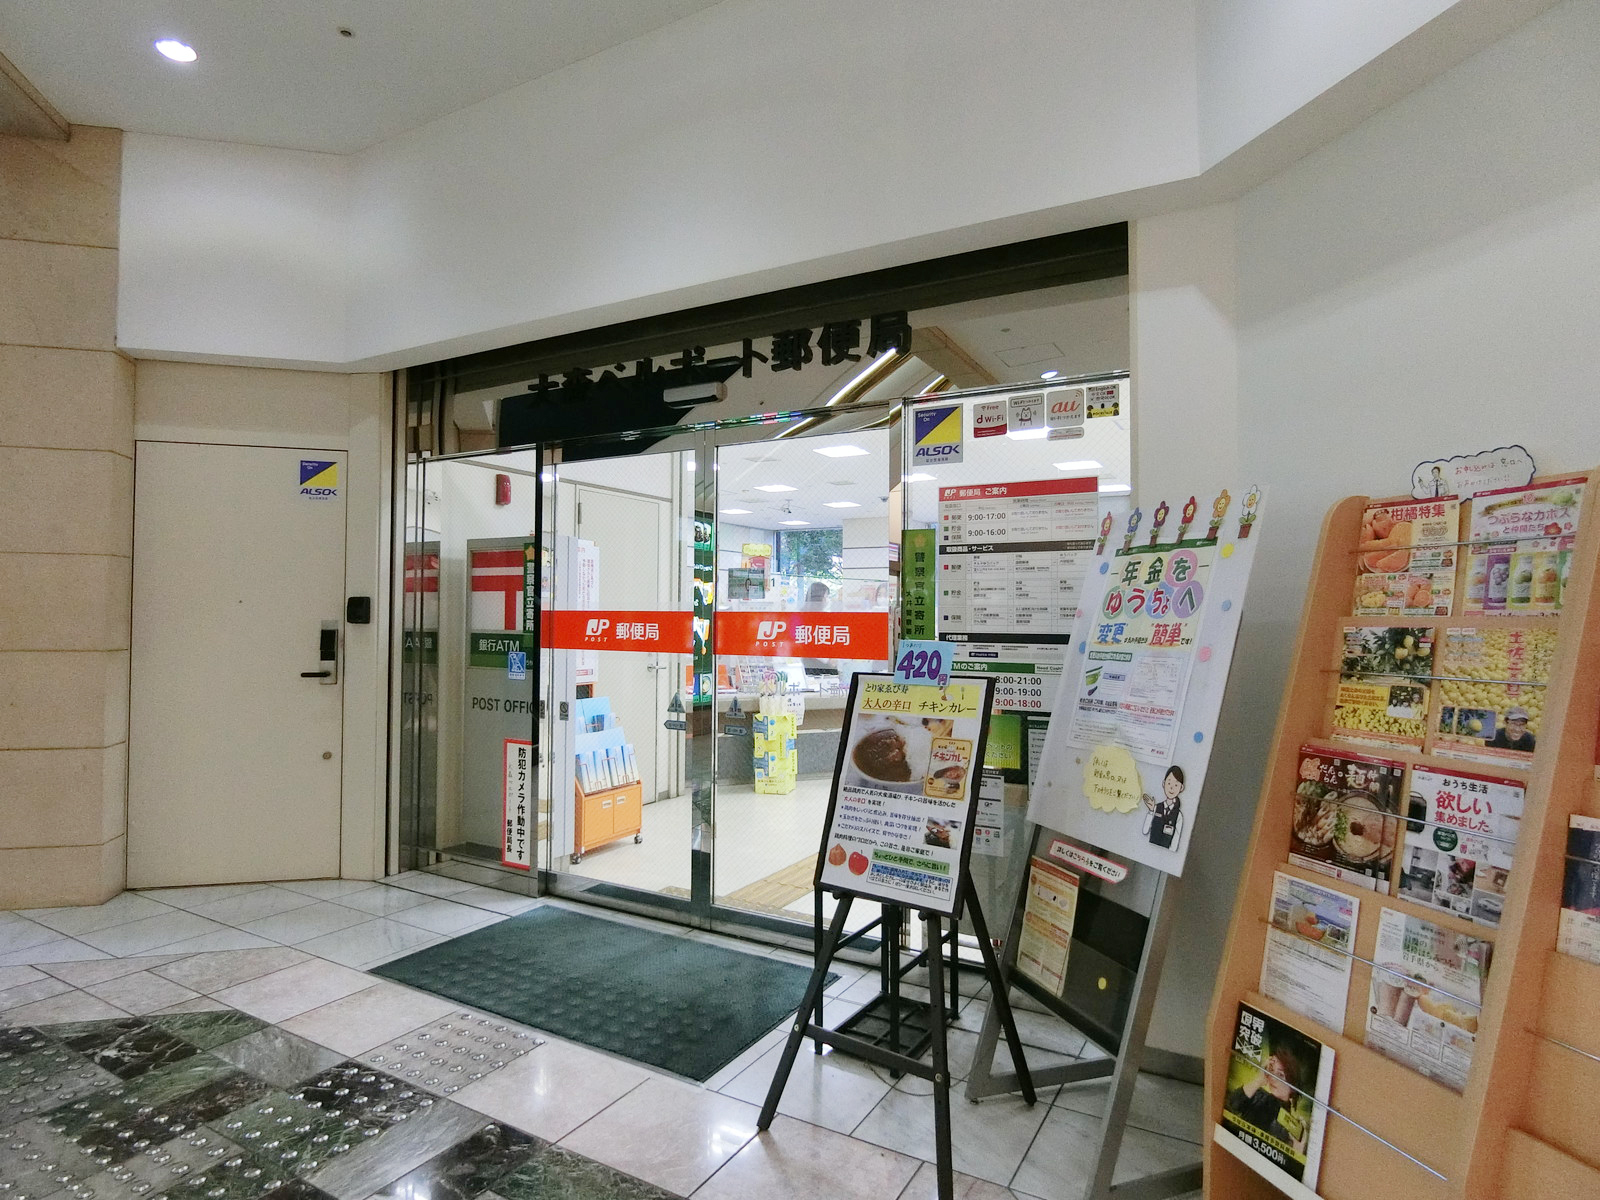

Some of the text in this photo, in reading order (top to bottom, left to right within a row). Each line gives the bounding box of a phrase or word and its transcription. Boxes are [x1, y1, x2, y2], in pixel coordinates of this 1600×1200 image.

[1051, 400, 1080, 414] au
[916, 445, 960, 456] ALSOK
[300, 488, 338, 496] ALSOK
[959, 486, 1007, 497] 郵便局 ご案内
[968, 512, 1006, 521] 9:00-17:00
[1391, 504, 1446, 520] 柑橘特集
[968, 528, 1006, 537] 9:00-16:00
[1503, 524, 1544, 534] と仲間たち
[1122, 557, 1192, 586] 年金を
[914, 552, 925, 636] 警察官立寄所
[1106, 587, 1196, 616] ゆうちょへ
[616, 622, 660, 640] 郵便局
[794, 625, 850, 646] 郵便局
[478, 640, 520, 652] 銀行ATM
[996, 676, 1042, 686] 8:00-21:00
[996, 687, 1042, 697] 9:00-19:00
[472, 697, 500, 712] POST
[862, 699, 977, 714] 大人の辛口 チキンカレー
[995, 698, 1042, 708] 9:00-18:00
[932, 752, 968, 762] チキンカレー
[1442, 778, 1489, 795] おうち生活
[516, 747, 527, 862] 防犯カメラ作動中です
[1436, 790, 1493, 815] 欲しい
[1240, 1010, 1265, 1032] 限界
[1238, 1026, 1263, 1048] 突破
